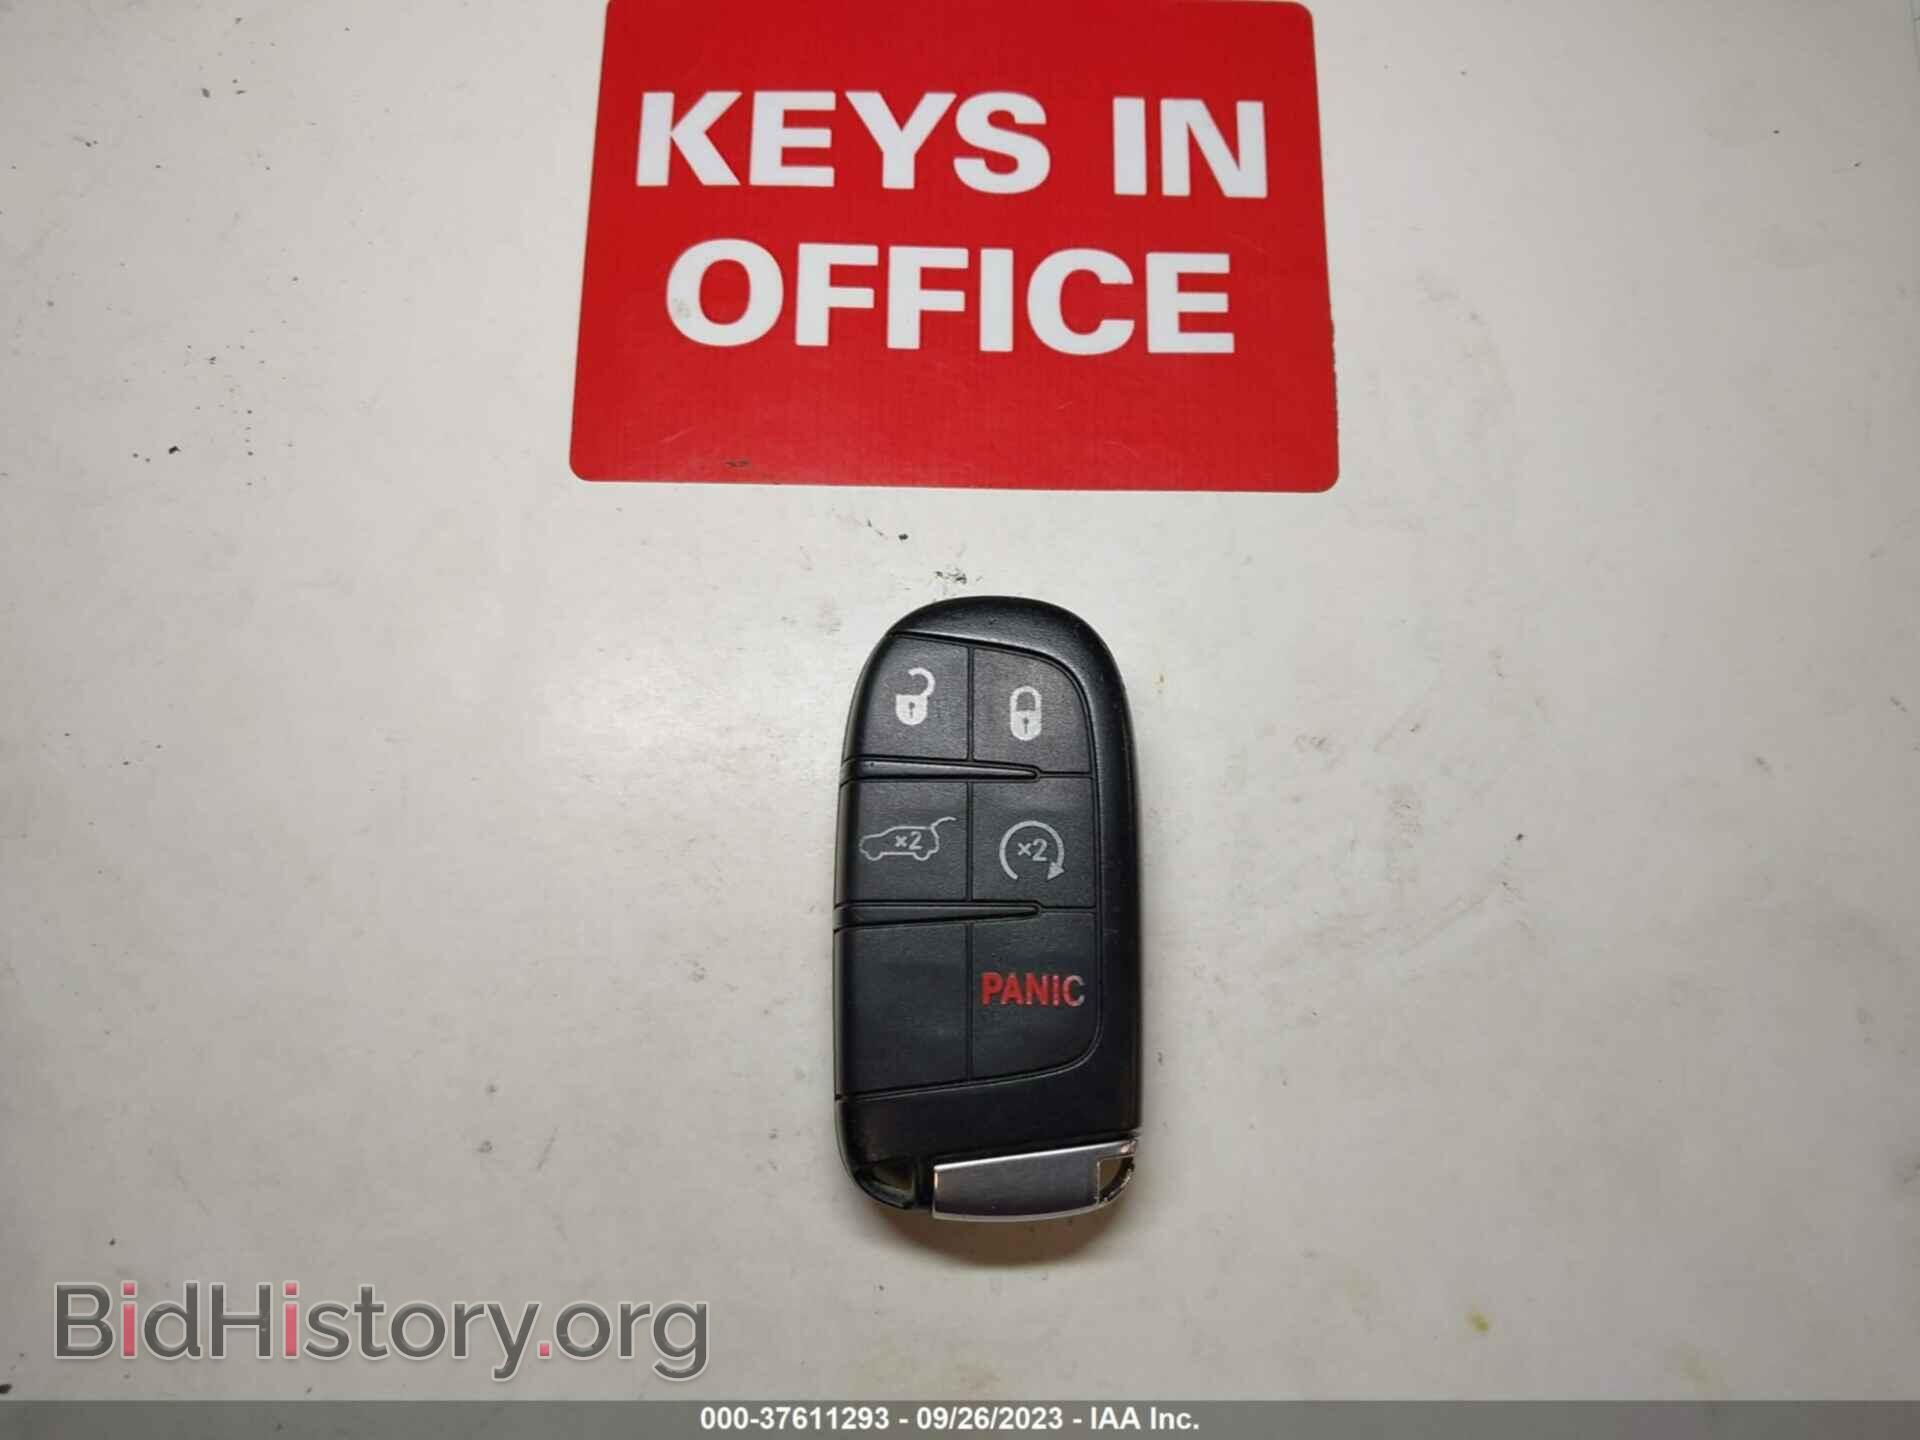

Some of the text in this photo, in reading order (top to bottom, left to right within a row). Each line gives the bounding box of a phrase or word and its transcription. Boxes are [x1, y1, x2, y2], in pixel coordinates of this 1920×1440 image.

[636, 90, 1269, 199] KEYS IN
[666, 238, 1236, 356] OFFICE
[981, 971, 1086, 1007] PANIC
